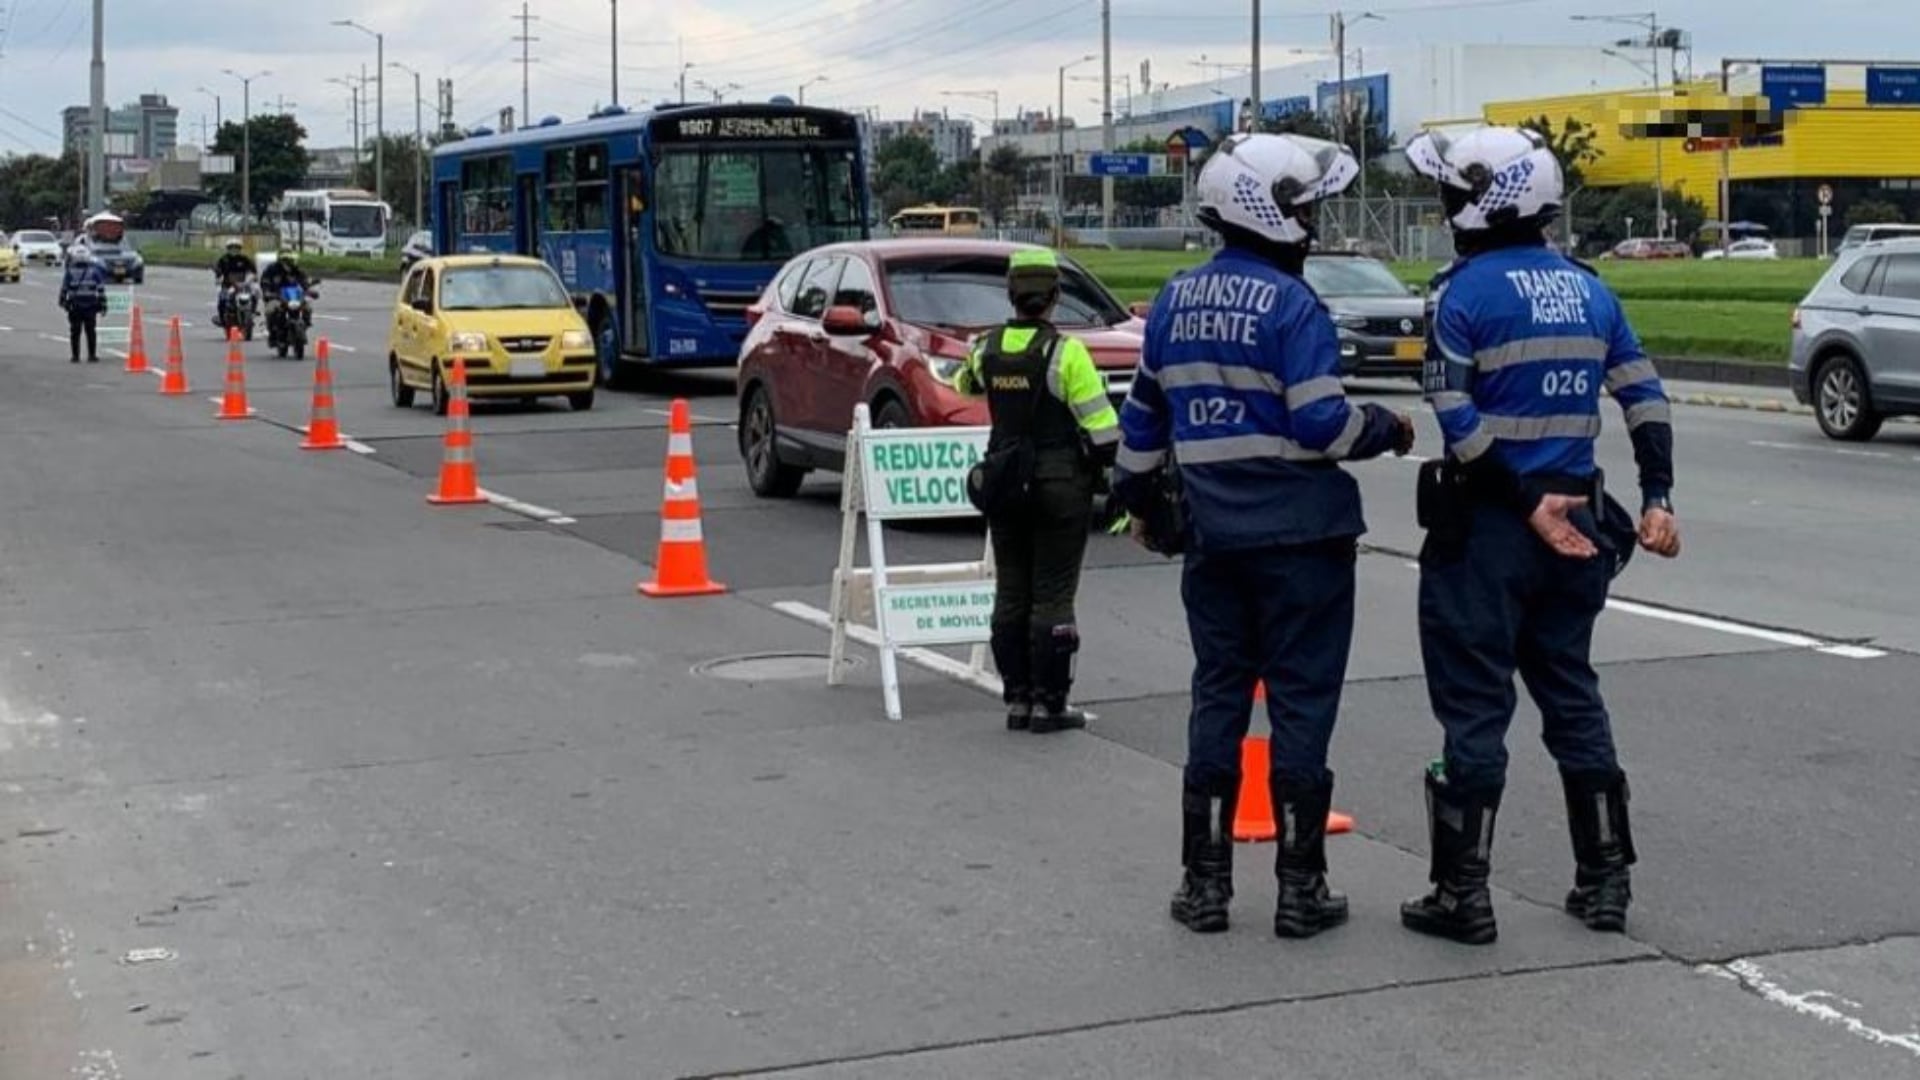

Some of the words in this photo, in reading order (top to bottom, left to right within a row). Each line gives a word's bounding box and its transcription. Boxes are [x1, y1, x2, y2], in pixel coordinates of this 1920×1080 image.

[1495, 159, 1534, 189] 026
[1169, 274, 1277, 313] TRANSITO
[1505, 269, 1591, 299] TRANSITO
[1532, 297, 1587, 325] AGENTE
[1170, 310, 1259, 346] AGENTE
[992, 375, 1030, 390] POLICIA
[1542, 369, 1589, 397] 026
[1189, 397, 1246, 426] 027
[873, 442, 979, 471] REDUZCA
[891, 595, 967, 610] SECRETARIA
[917, 617, 933, 629] DE
